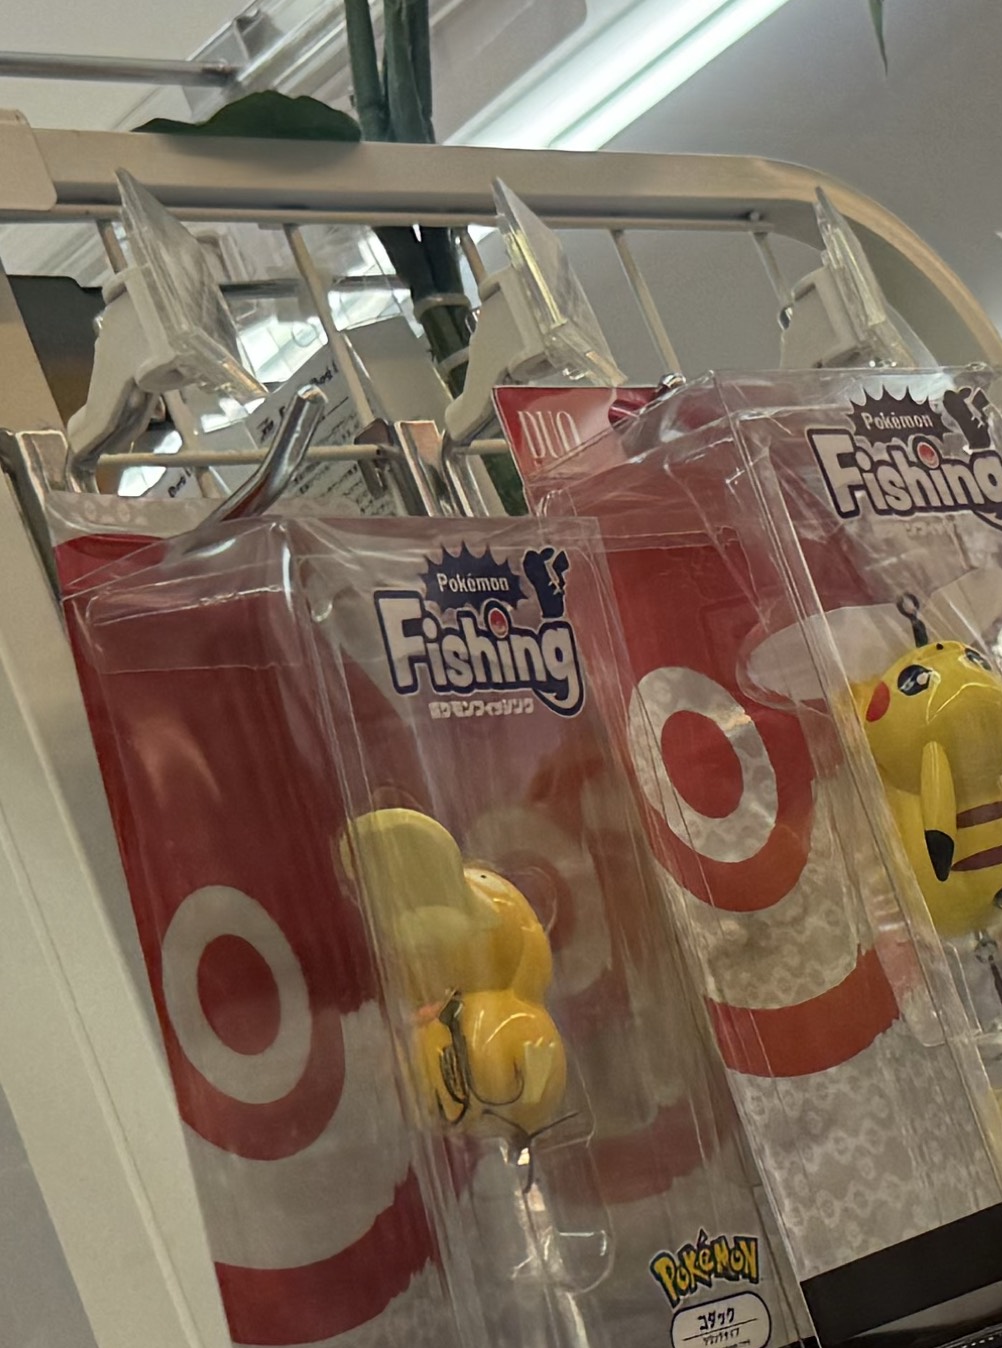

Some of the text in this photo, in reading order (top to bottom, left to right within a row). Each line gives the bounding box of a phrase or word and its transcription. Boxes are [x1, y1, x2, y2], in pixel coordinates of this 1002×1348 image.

[861, 411, 934, 431] Pokémon
[517, 411, 582, 462] DUO
[436, 573, 510, 593] Pokémon
[374, 588, 584, 718] Fishing
[697, 1307, 735, 1331] コダック
